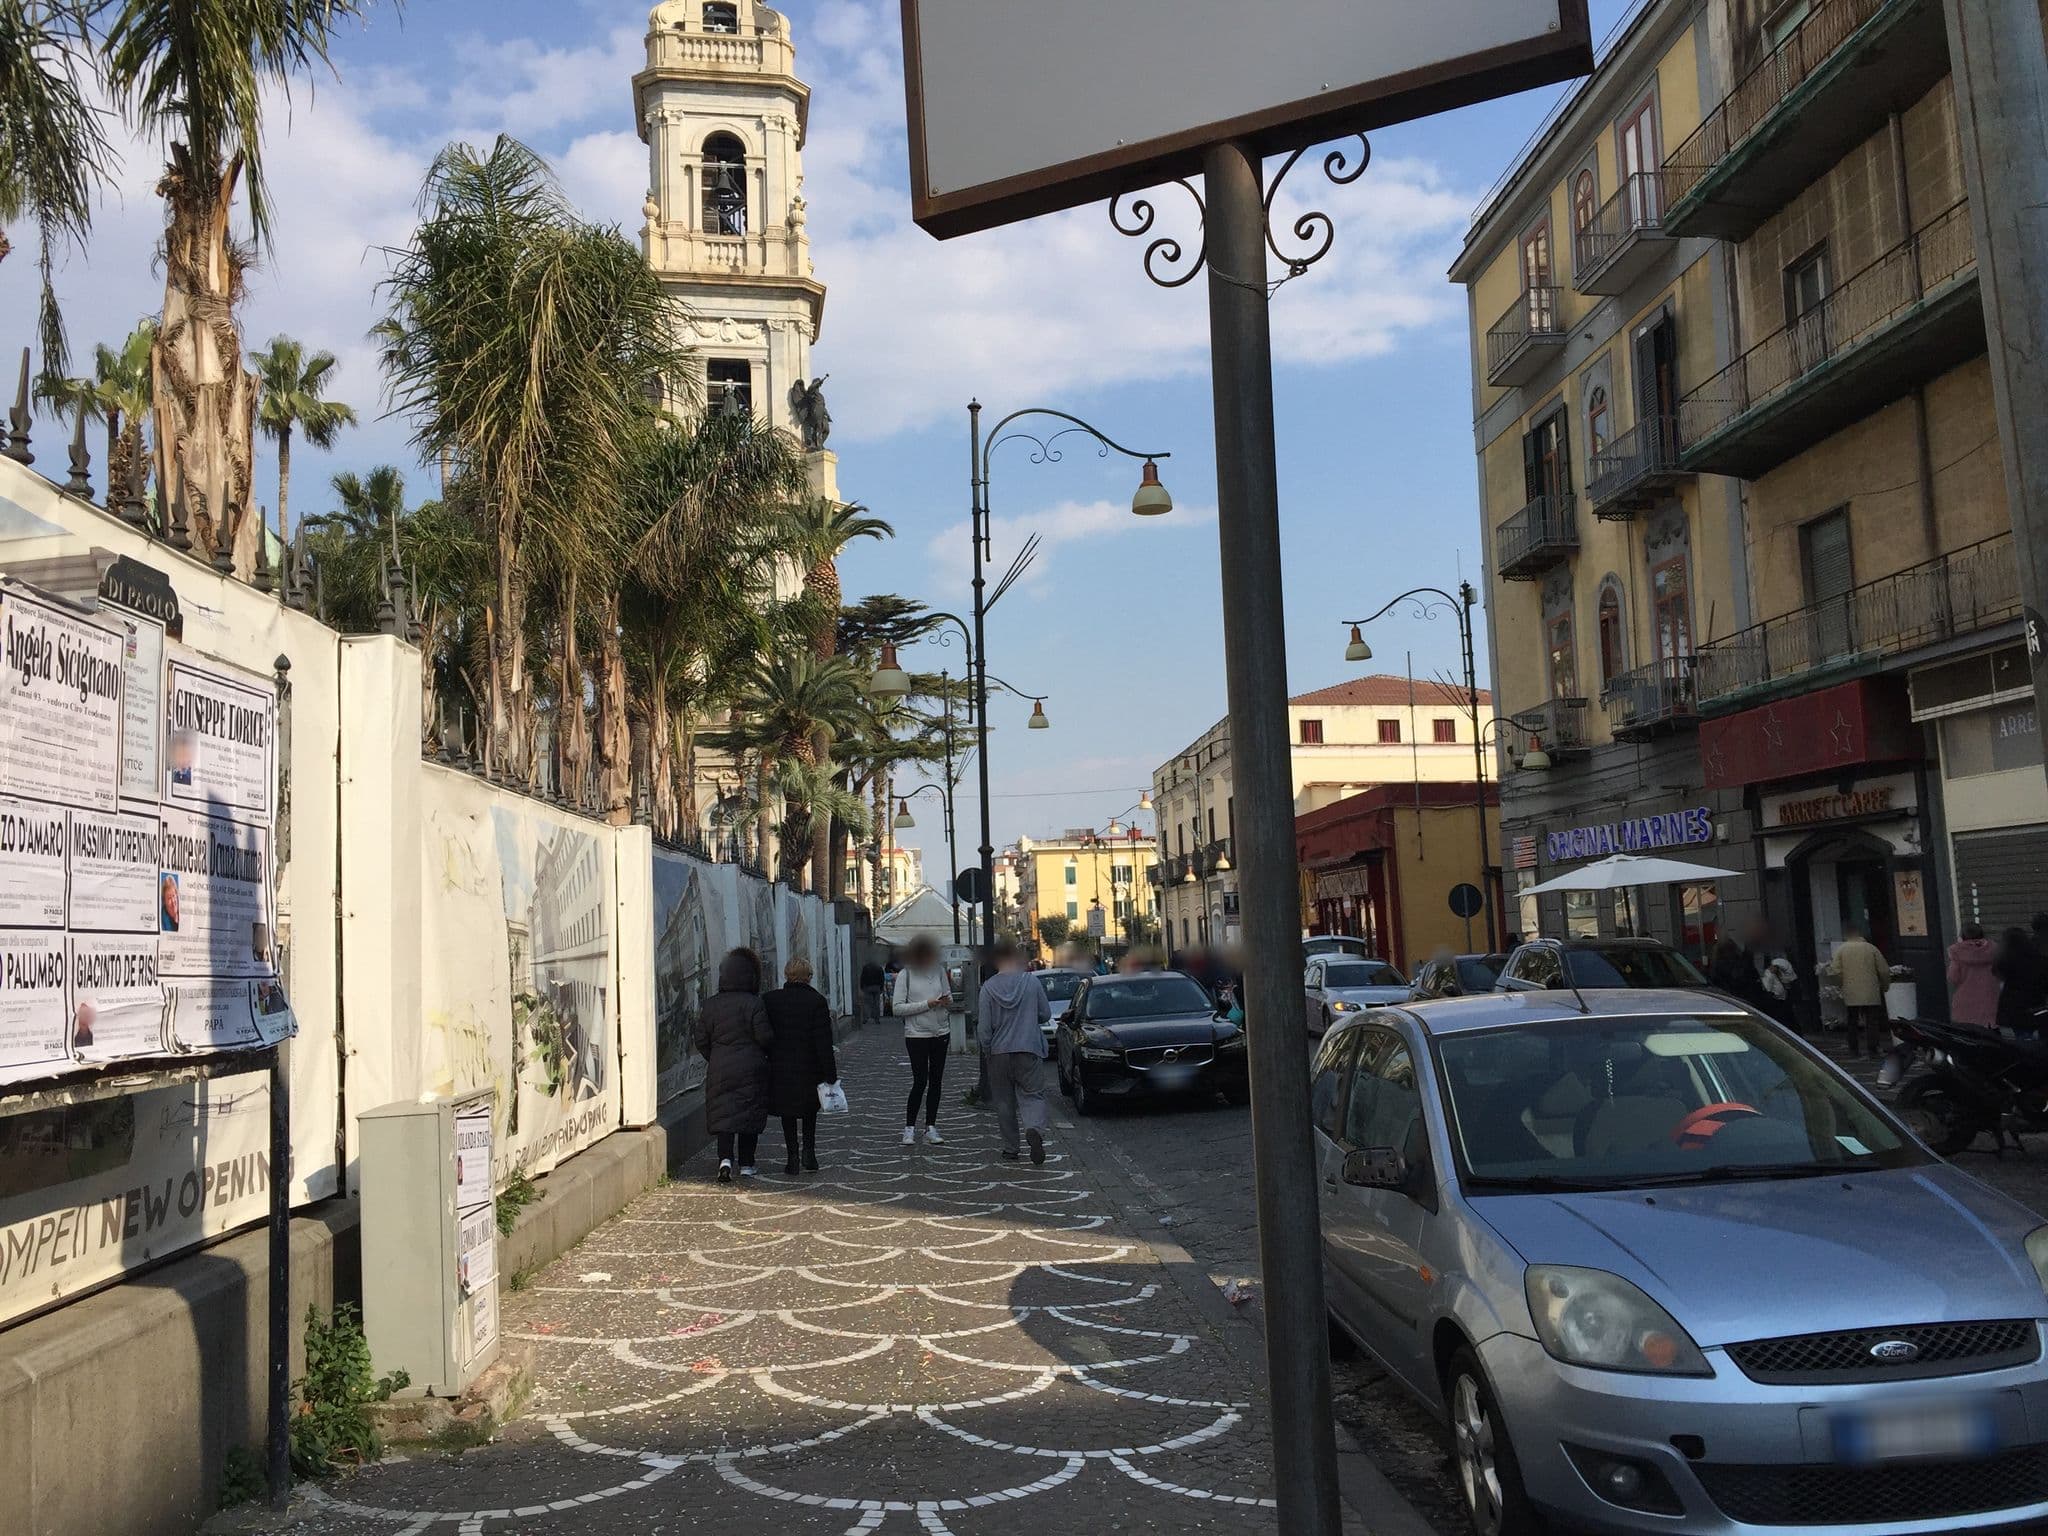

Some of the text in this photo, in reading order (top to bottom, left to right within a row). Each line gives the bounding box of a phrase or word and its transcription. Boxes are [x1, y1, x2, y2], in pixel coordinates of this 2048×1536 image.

[108, 576, 176, 621] DI PAOLO
[6, 614, 52, 687] Angela
[56, 632, 119, 704] Sicignano
[18, 688, 33, 699] anni
[176, 689, 226, 738] GIUSEPPE
[19, 817, 63, 858] D'AMARO
[73, 822, 158, 864] MASSIMO FIORENTINO
[161, 821, 207, 877] Francesca
[1546, 807, 1713, 861] ORIGINAL MARINES
[8, 952, 63, 989] PALUMBO
[77, 954, 122, 989] GIACINTO
[124, 954, 136, 987] DE
[100, 1177, 173, 1249] NEW
[1881, 1343, 1909, 1357] Ford
